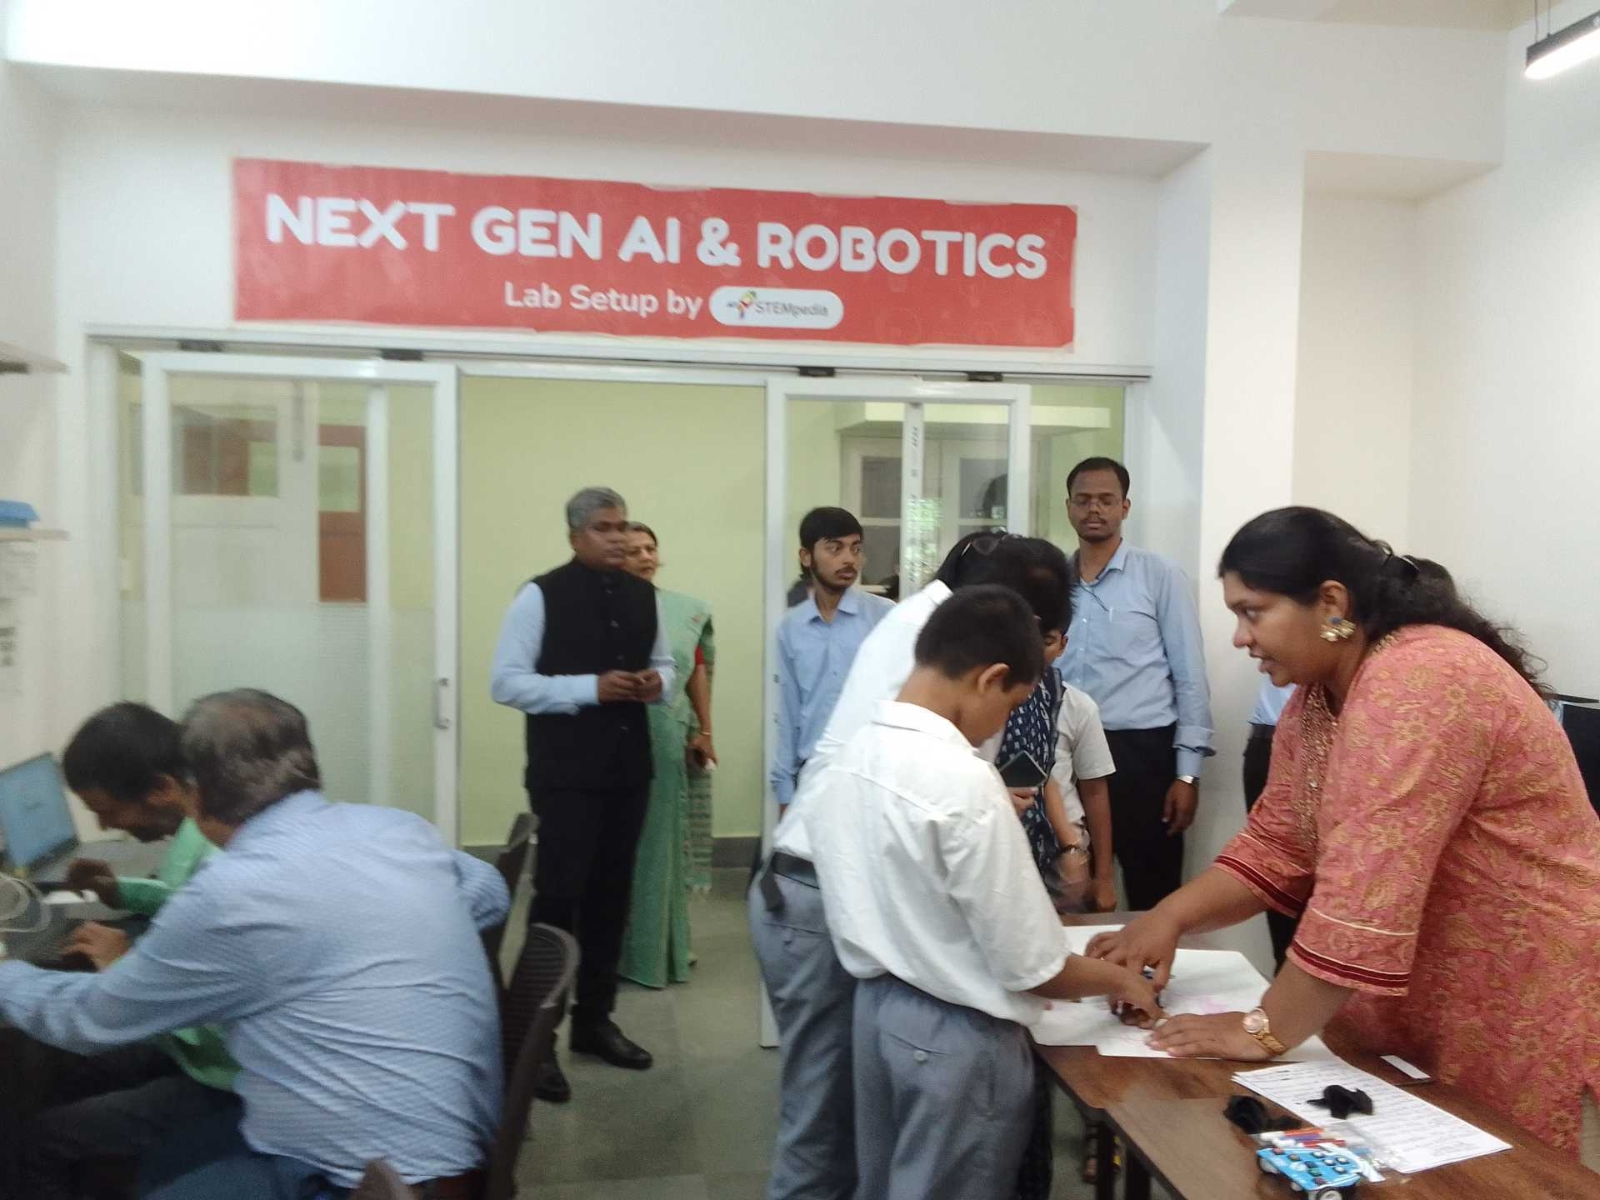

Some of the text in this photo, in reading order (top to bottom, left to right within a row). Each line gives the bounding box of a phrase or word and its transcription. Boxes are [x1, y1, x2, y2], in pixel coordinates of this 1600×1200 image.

[265, 193, 1048, 280] NEXT GEN AI & ROBOTICS
[504, 280, 829, 321] Lab Setup by STEMpedia
